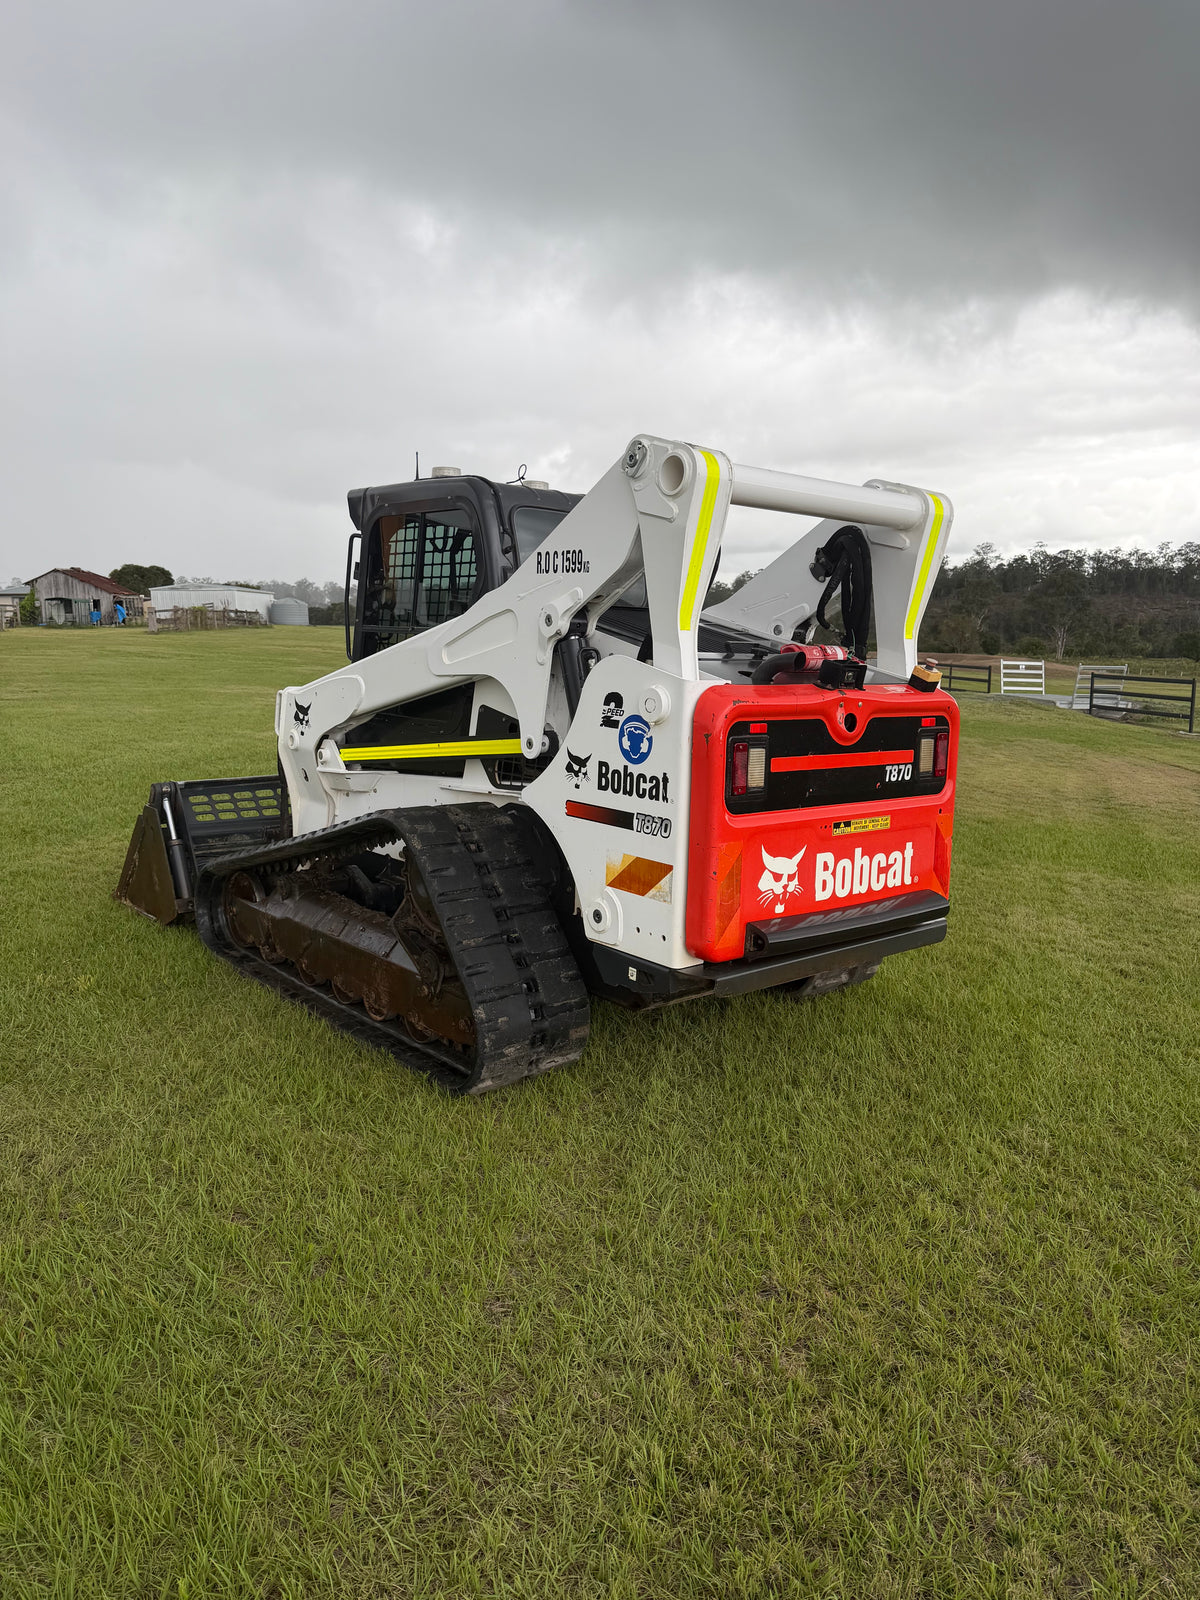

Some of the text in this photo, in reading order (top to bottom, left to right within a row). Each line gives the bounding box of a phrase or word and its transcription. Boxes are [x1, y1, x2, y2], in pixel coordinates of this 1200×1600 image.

[597, 760, 670, 803] Bobcat
[885, 764, 913, 782] T870
[635, 812, 672, 839] T870
[815, 841, 914, 902] Bobcat
